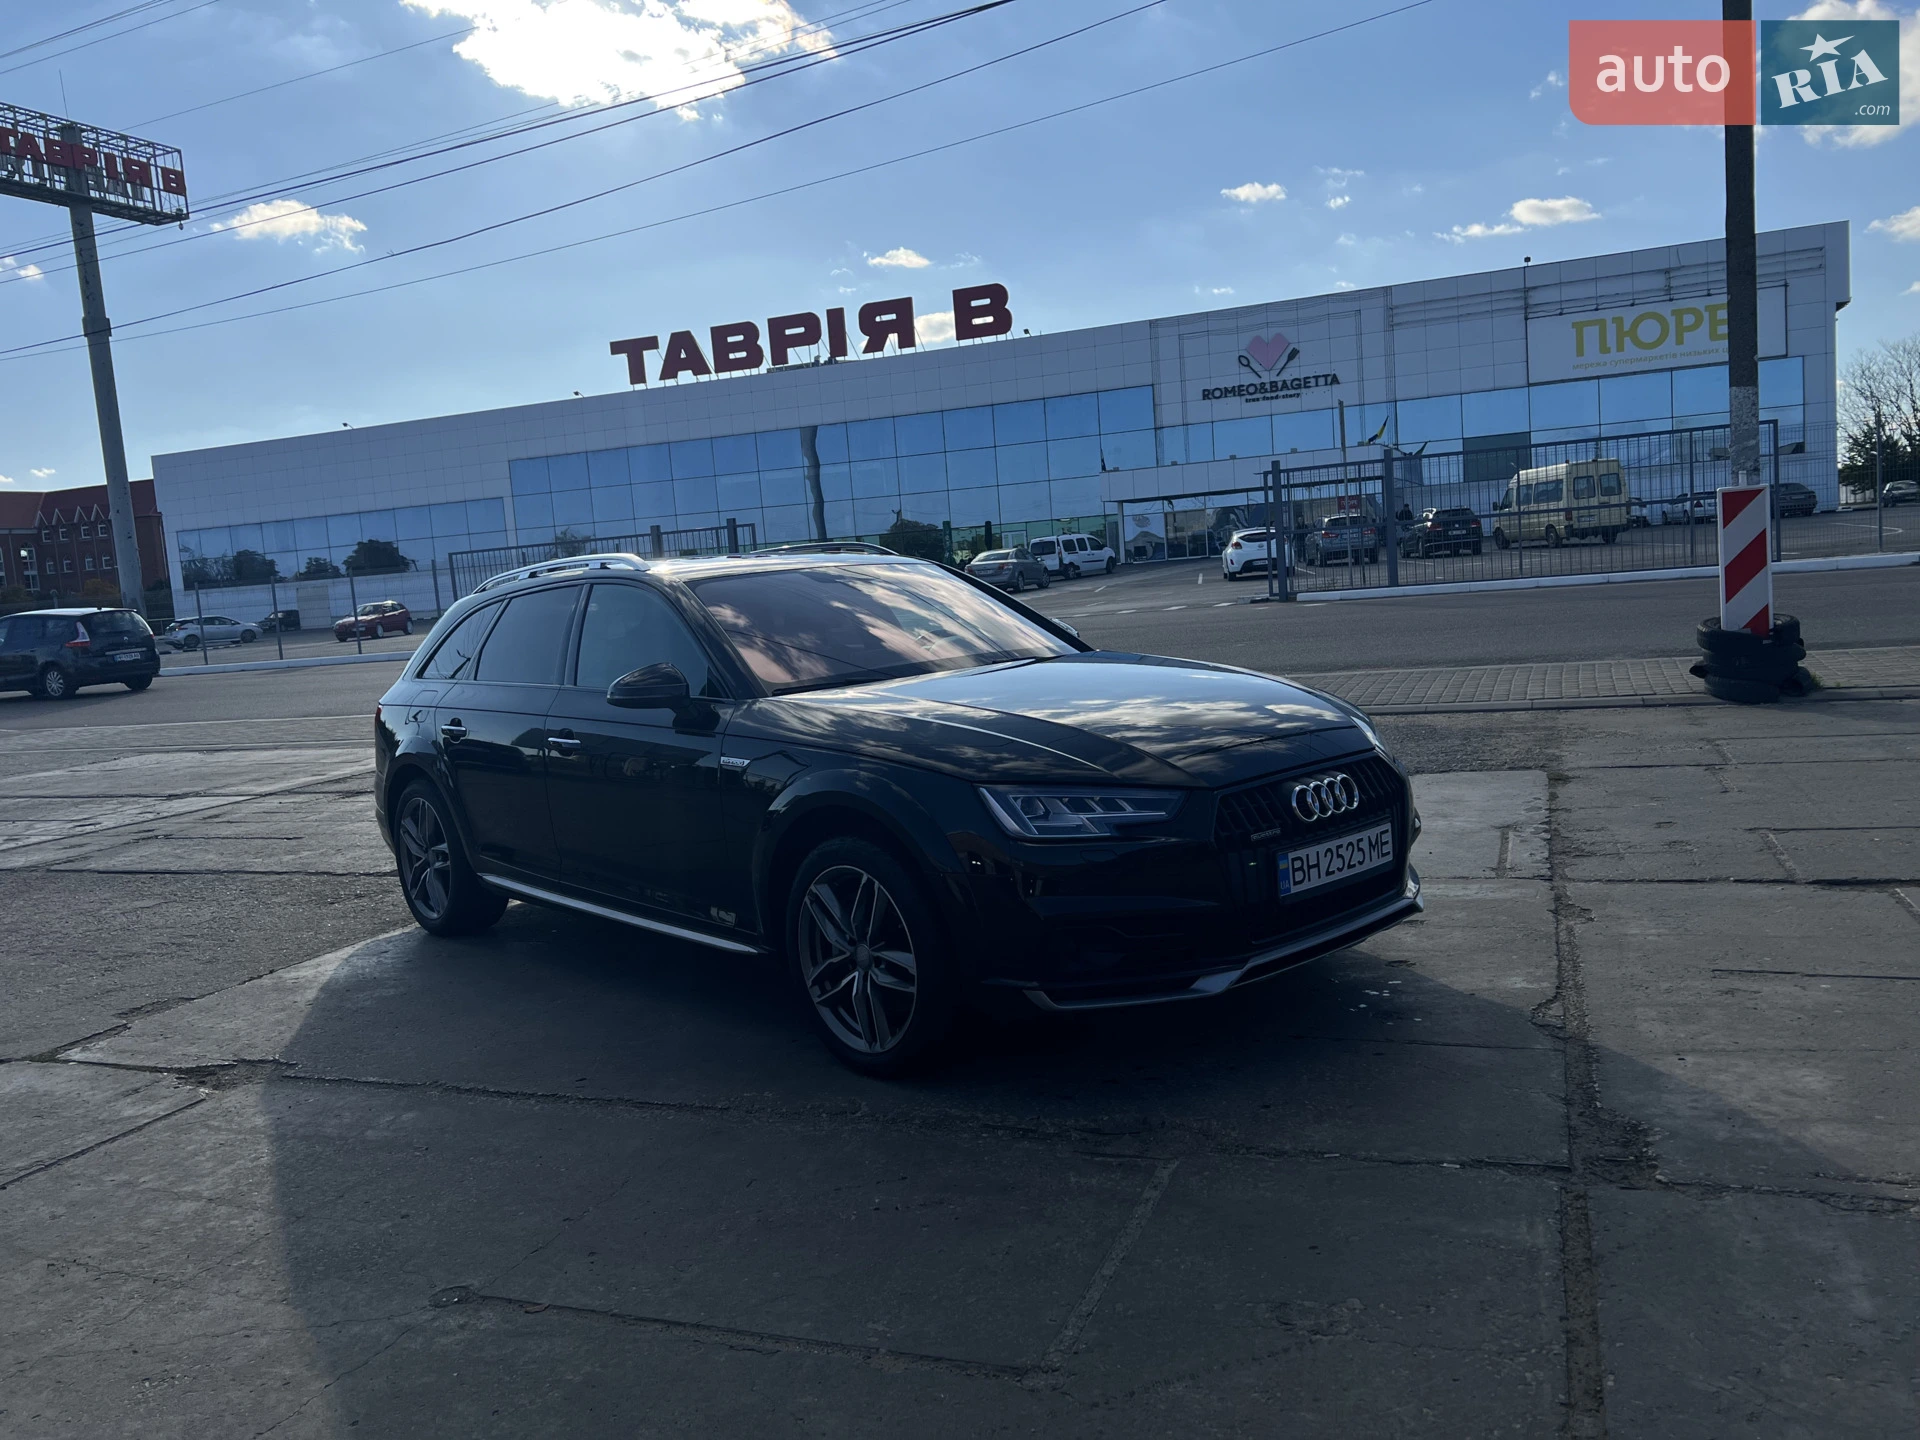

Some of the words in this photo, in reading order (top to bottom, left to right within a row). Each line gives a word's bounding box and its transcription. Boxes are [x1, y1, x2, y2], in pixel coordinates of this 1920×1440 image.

[161, 166, 186, 196] В
[609, 297, 916, 385] ТАВРІЯ
[952, 283, 1012, 341] В
[1571, 303, 1729, 358] ПЮРЕ
[1202, 374, 1340, 400] ROMEO&BAGETTA
[1291, 850, 1321, 887] BH
[1324, 837, 1366, 877] 2525
[1367, 828, 1391, 862] ME
